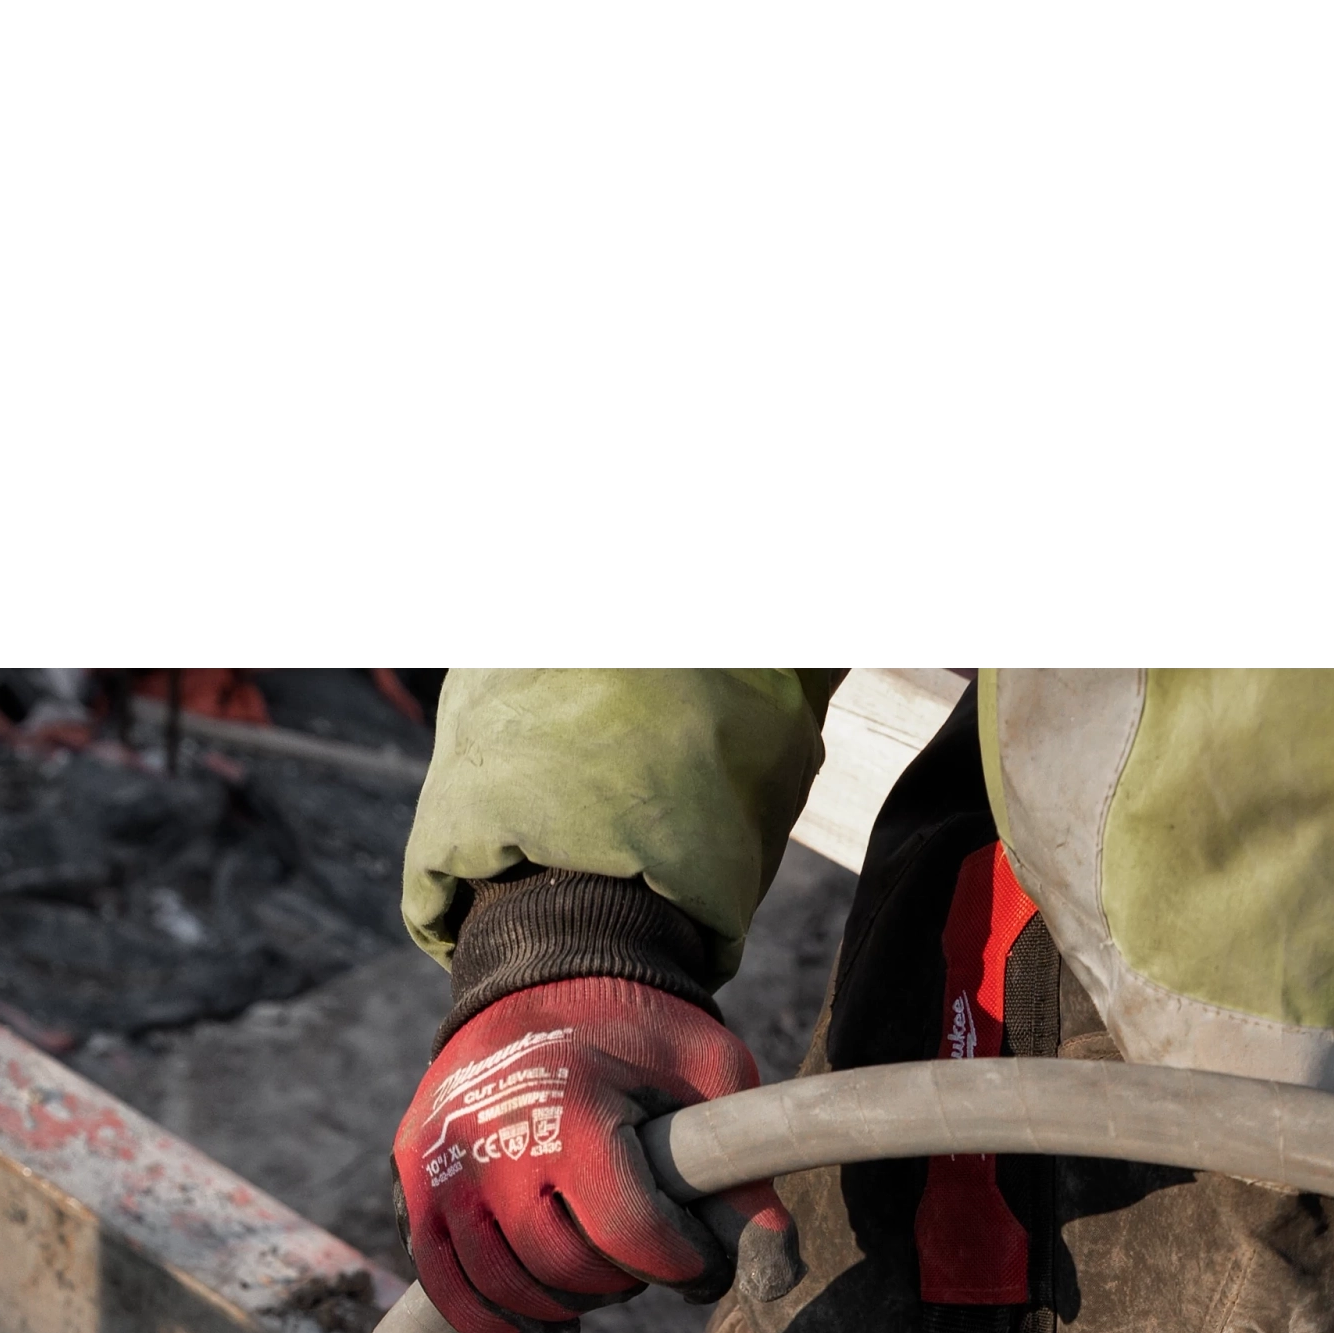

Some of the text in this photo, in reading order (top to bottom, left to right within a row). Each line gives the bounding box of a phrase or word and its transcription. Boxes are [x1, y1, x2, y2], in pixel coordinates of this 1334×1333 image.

[464, 1083, 496, 1105] CUT
[498, 1068, 550, 1090] LEVEL
[447, 1144, 467, 1160] XL
